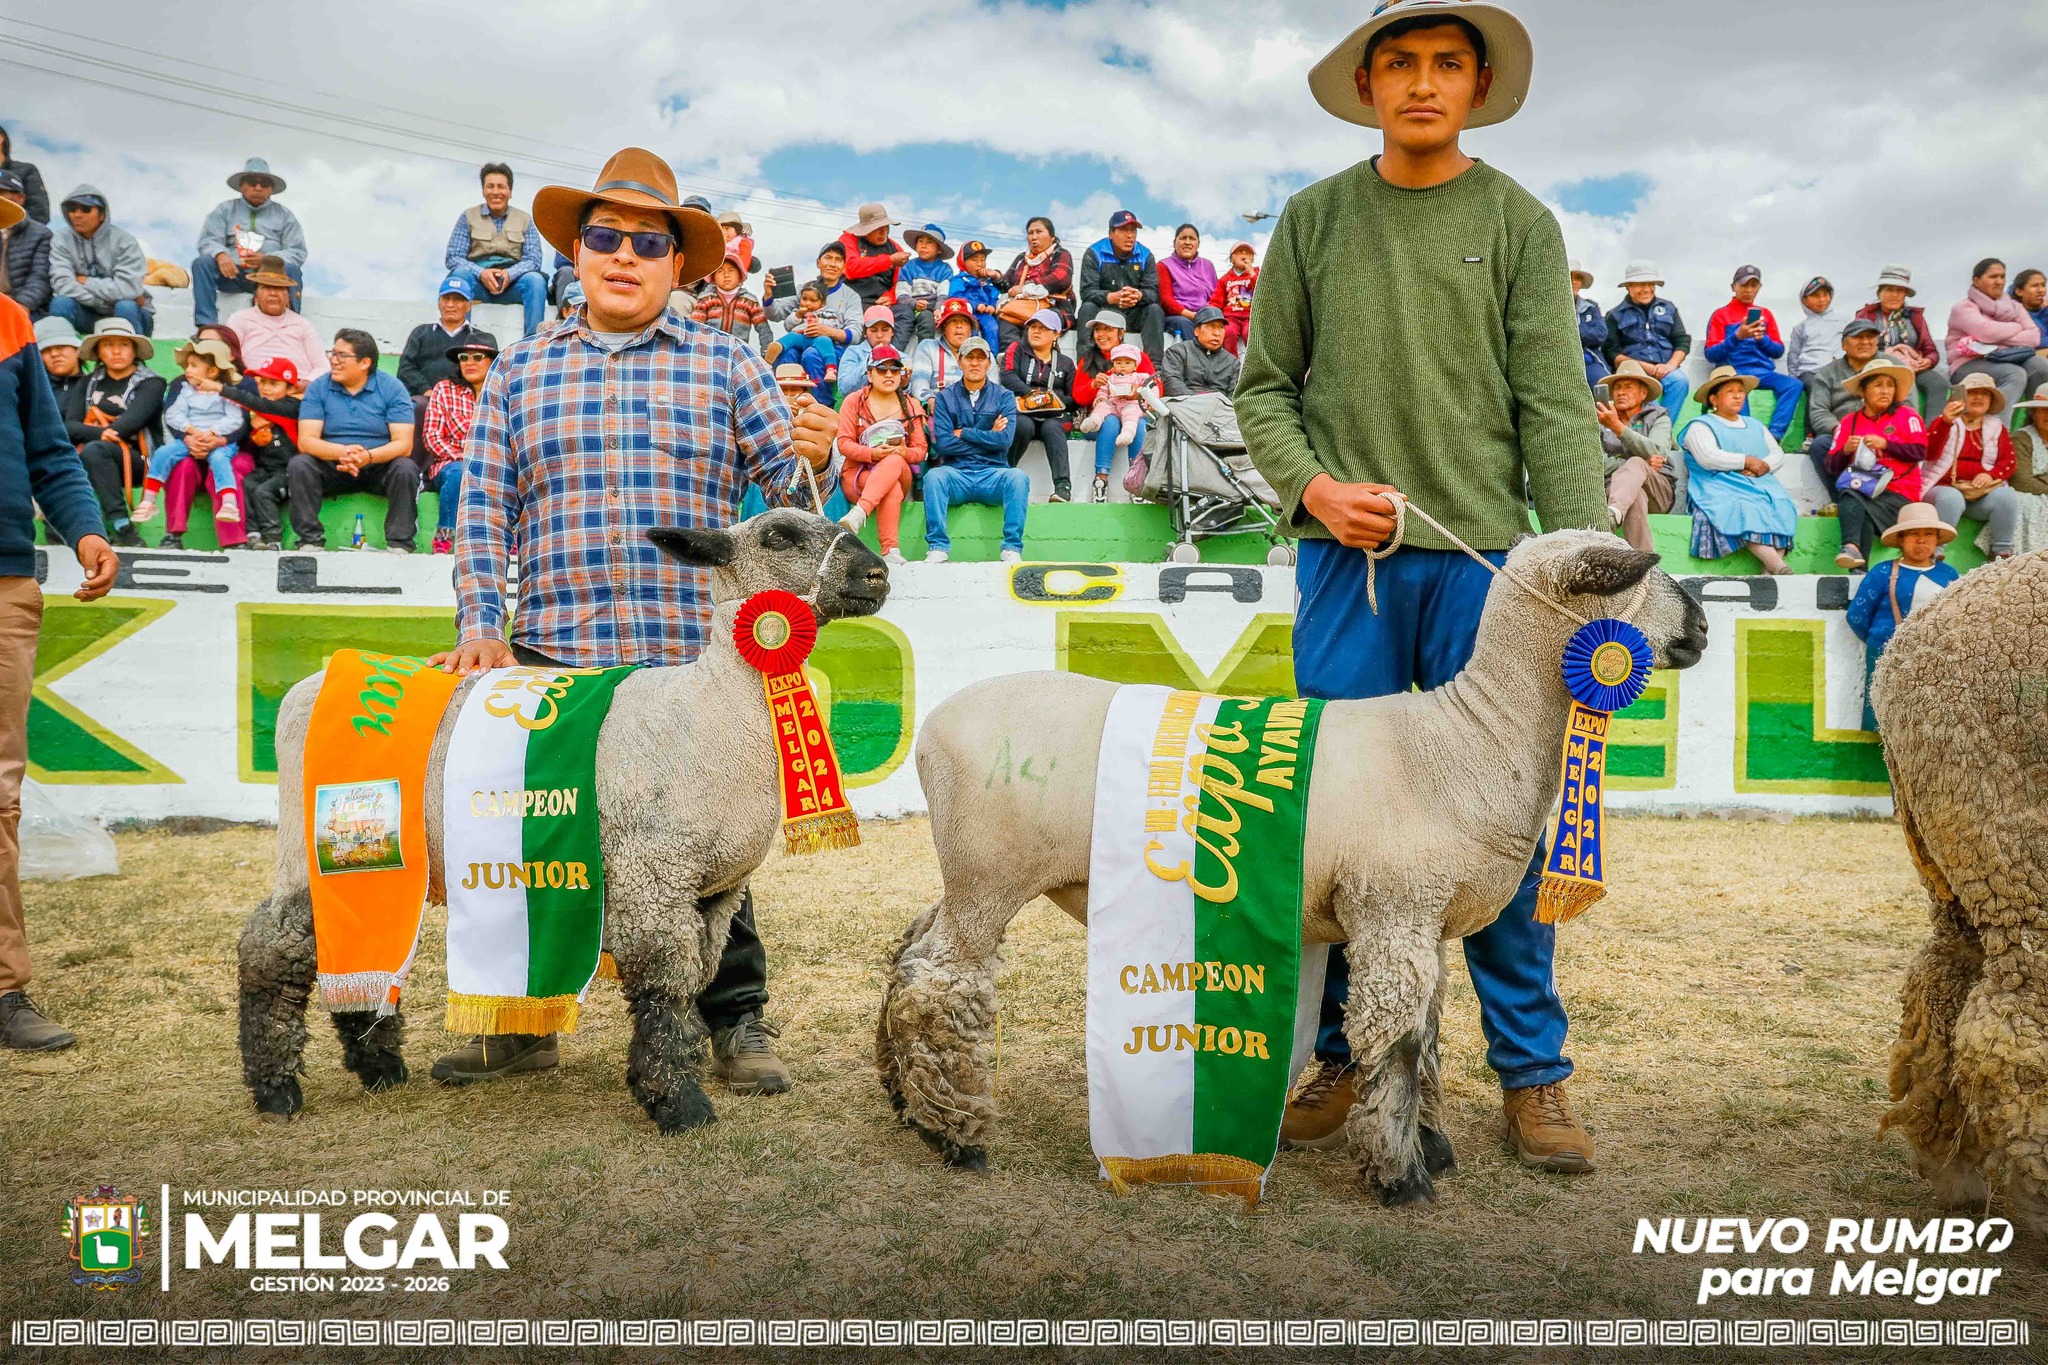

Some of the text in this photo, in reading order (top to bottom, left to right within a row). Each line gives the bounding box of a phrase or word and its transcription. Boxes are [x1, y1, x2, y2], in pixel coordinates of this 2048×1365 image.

[769, 670, 802, 693] EXPO
[1574, 710, 1605, 736] EXPO
[774, 702, 816, 812] MELGAR
[799, 699, 834, 808] 2024
[1147, 759, 1185, 798] FERIA
[469, 787, 579, 818] CAMPEON
[1143, 720, 1275, 904] Expo
[1559, 740, 1584, 872] MELGAR
[1580, 749, 1601, 877] 2024
[461, 859, 591, 891] JUNIOR
[1119, 960, 1266, 995] CAMPEON
[1123, 1023, 1271, 1060] JUNIOR
